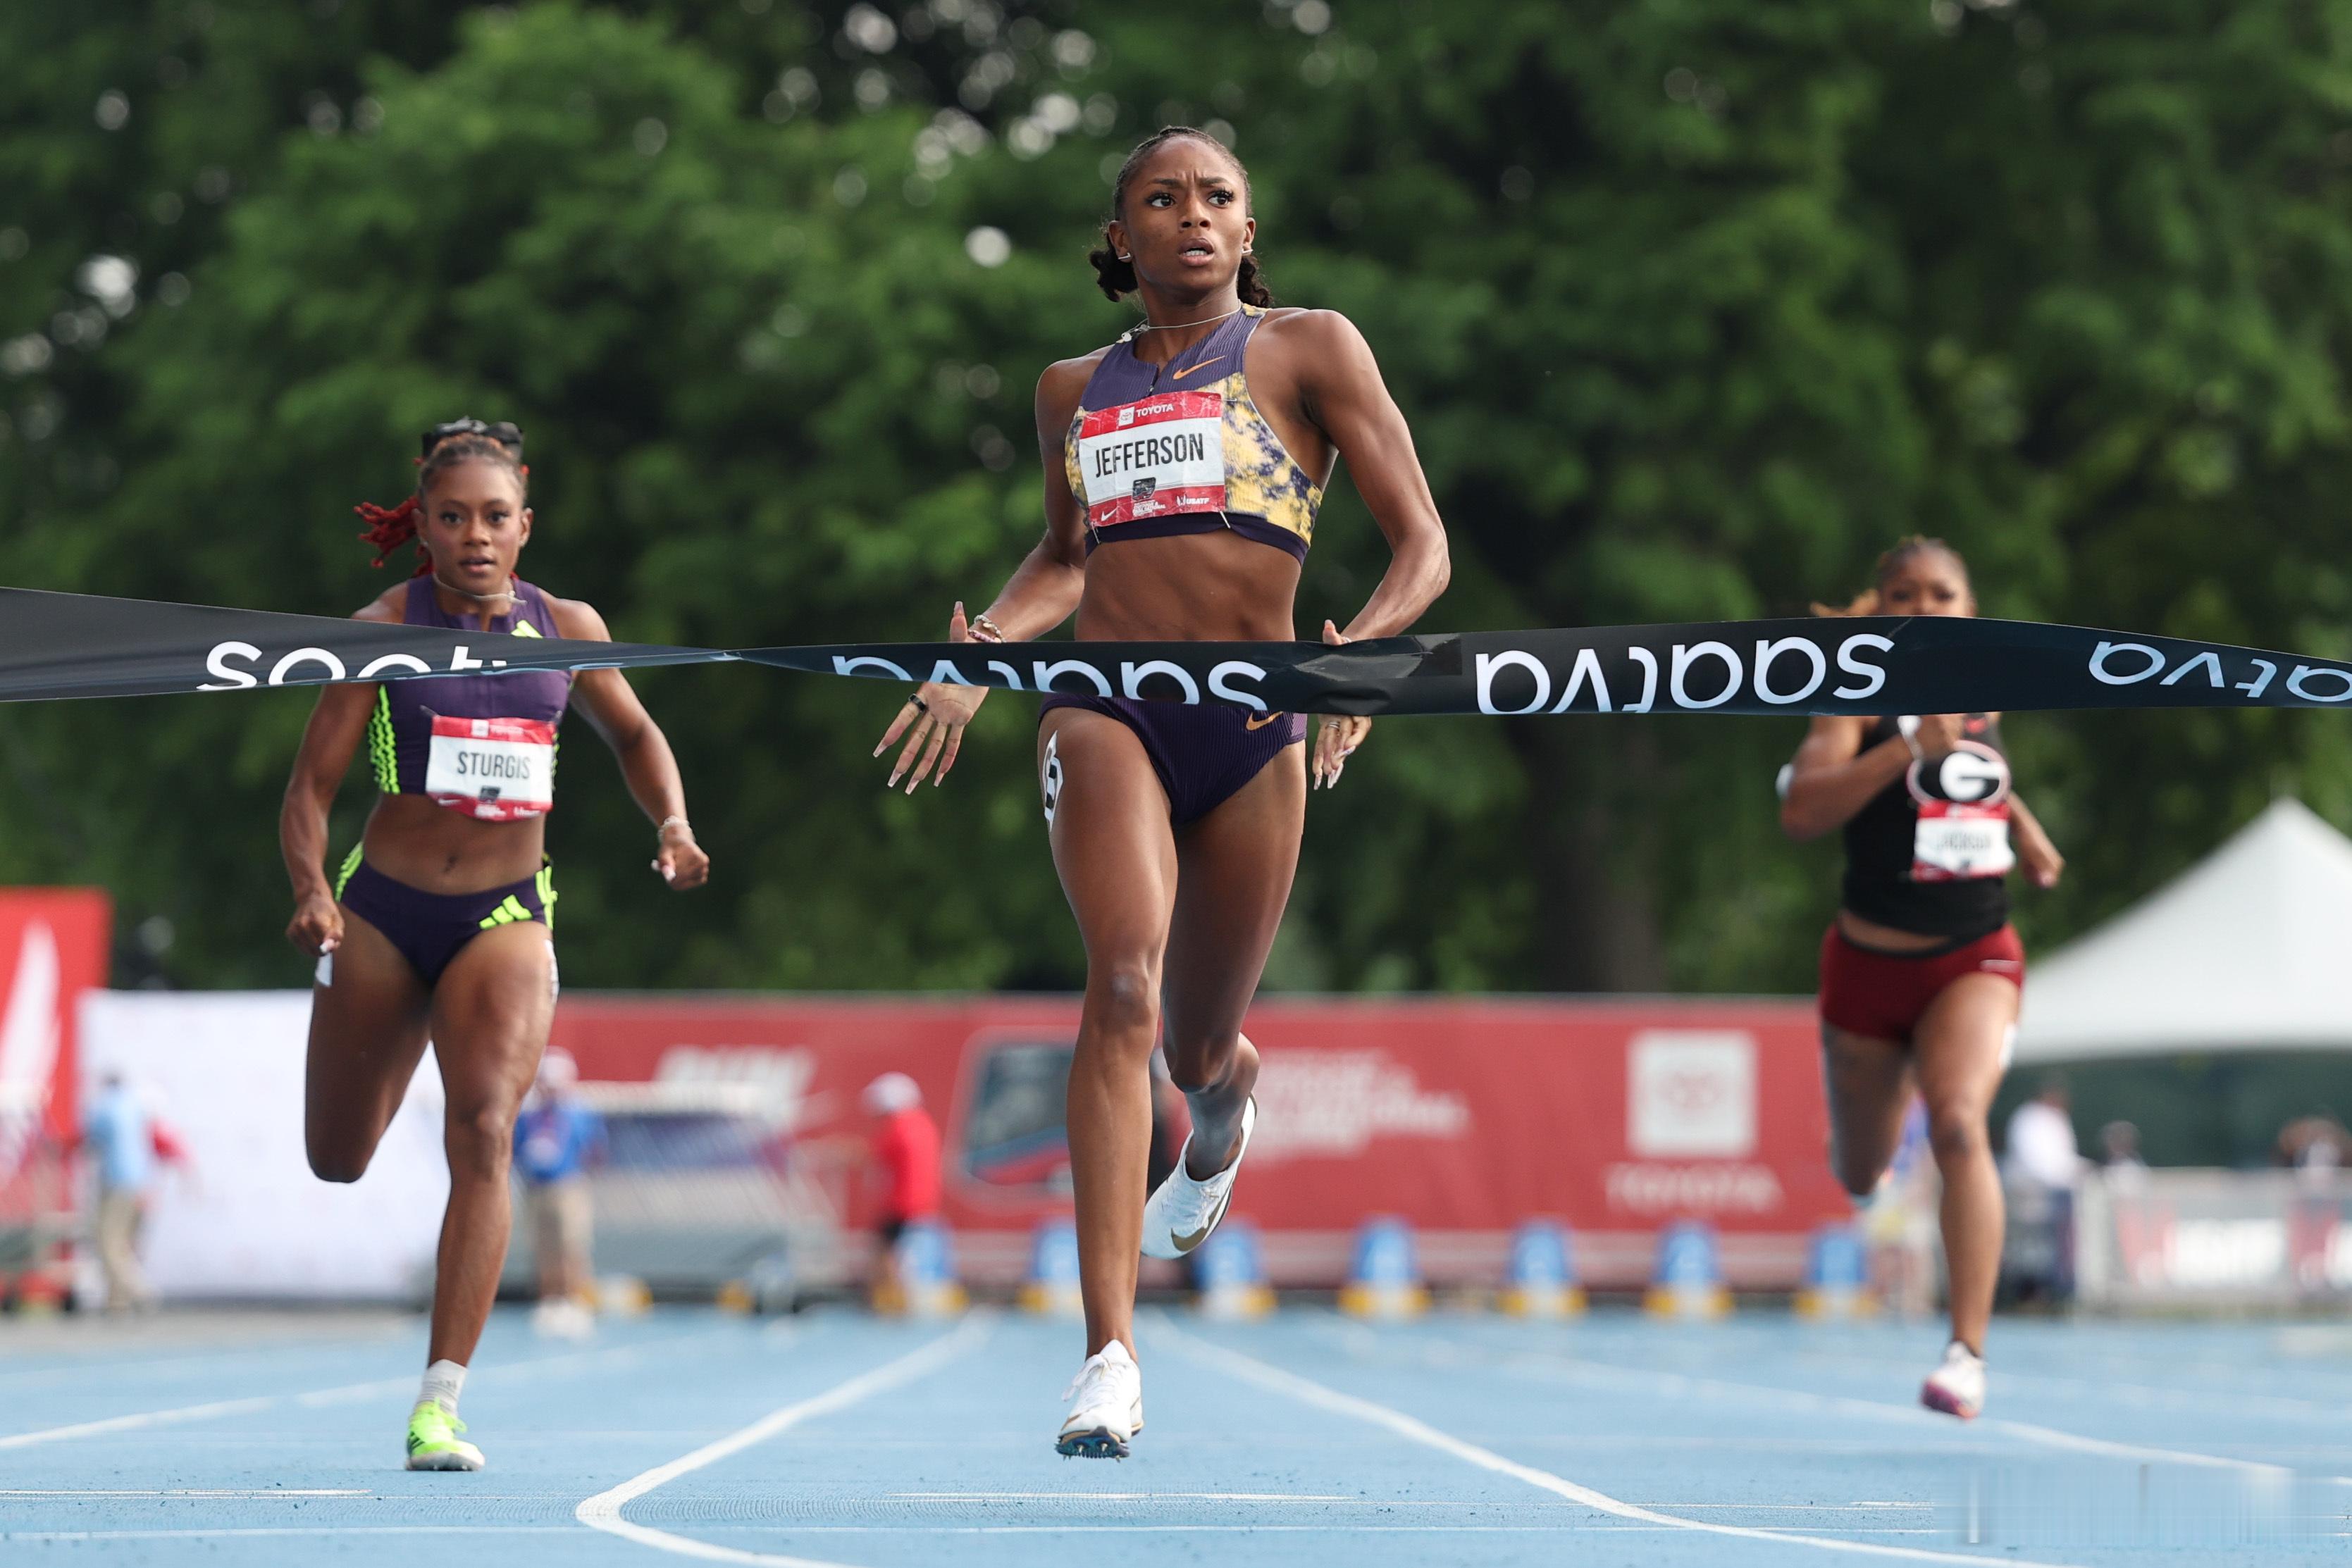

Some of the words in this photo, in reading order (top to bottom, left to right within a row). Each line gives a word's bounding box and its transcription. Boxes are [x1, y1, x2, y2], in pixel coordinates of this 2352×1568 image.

[1136, 404, 1174, 418] TOYOTA
[1095, 433, 1204, 478] JEFFERSON
[1475, 634, 1895, 714] saatva
[2088, 641, 2352, 702] atva
[457, 751, 531, 780] STURGIS
[1939, 751, 2007, 802] G
